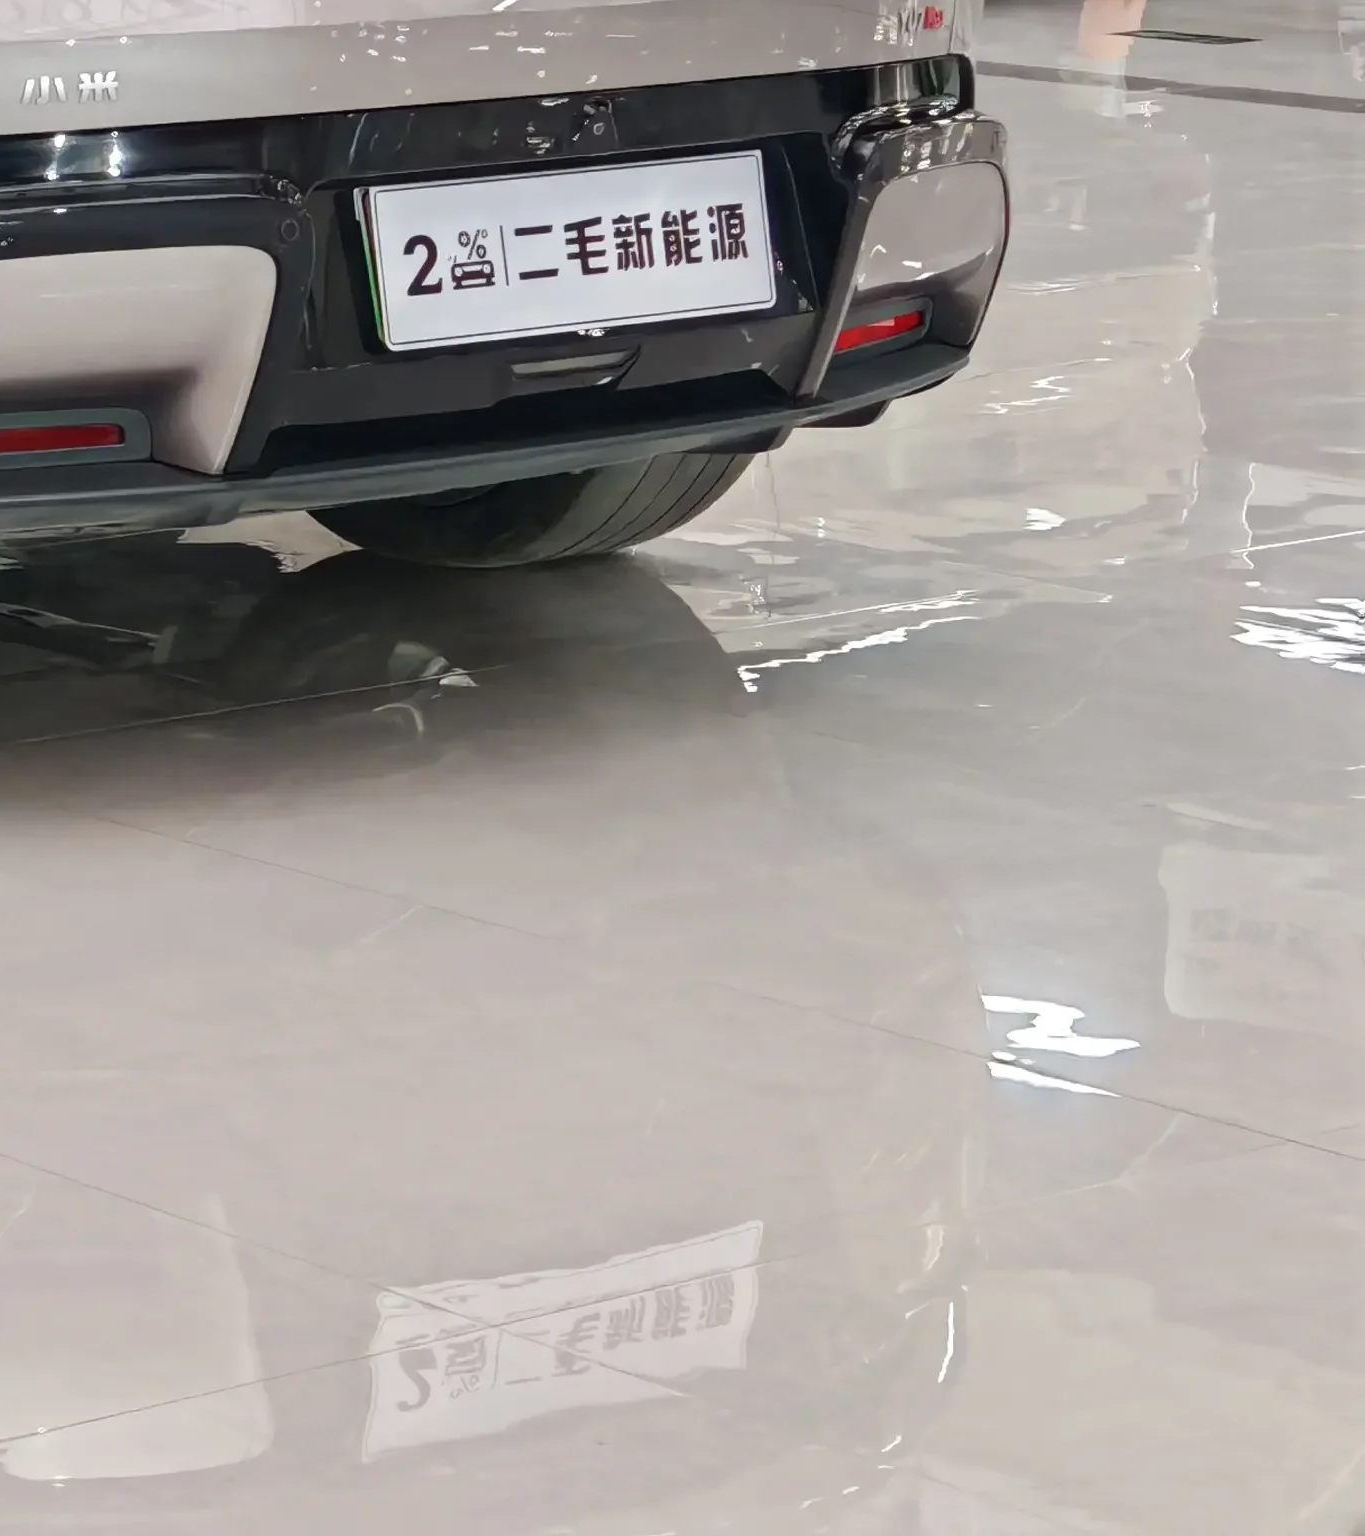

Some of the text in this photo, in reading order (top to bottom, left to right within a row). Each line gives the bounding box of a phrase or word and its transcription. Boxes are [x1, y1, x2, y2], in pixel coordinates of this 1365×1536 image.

[20, 70, 119, 105] 小米
[514, 203, 748, 281] 二毛新能源
